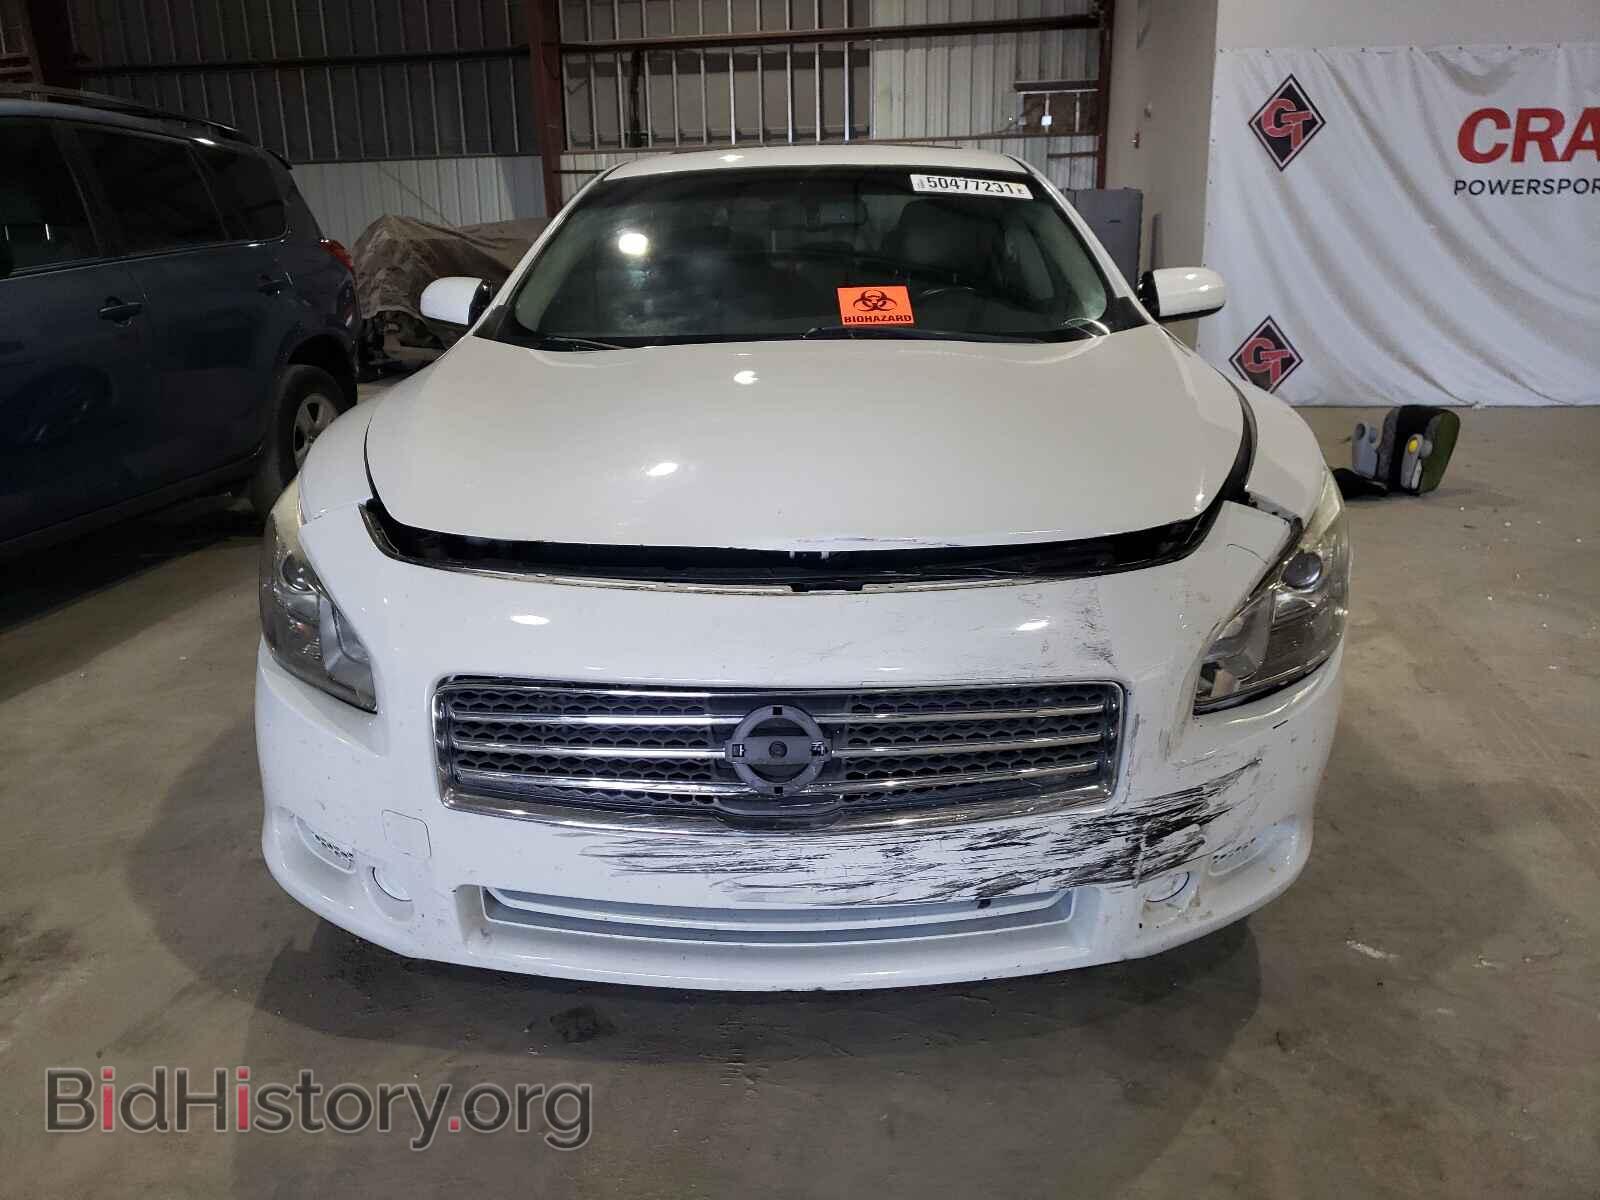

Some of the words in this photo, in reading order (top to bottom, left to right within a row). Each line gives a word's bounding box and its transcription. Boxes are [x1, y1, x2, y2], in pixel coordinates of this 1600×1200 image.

[1457, 107, 1600, 163] CRA
[926, 176, 1013, 194] 50477231
[843, 314, 912, 323] BIOHAZARD
